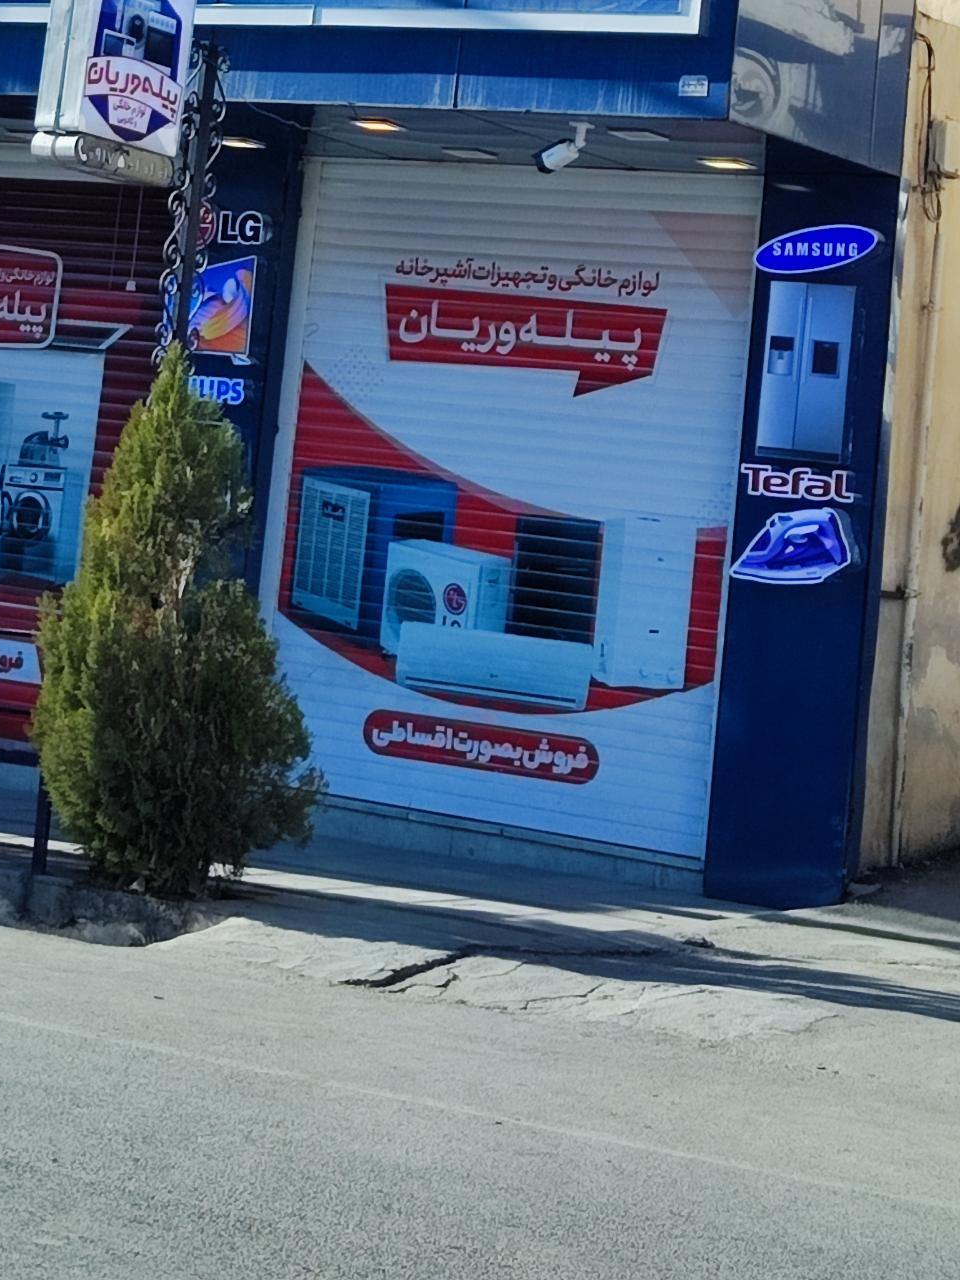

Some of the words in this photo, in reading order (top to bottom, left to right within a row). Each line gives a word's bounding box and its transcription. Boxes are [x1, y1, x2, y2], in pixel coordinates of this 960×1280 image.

[219, 210, 263, 245] LG
[772, 242, 859, 257] SAMSUNG
[472, 261, 549, 290] تجهیزات
[558, 264, 617, 291] خانگی
[618, 270, 660, 297] لوازم
[741, 463, 855, 503] Tefal
[372, 720, 453, 750] اقساطی
[453, 731, 523, 767] بصورت
[522, 737, 589, 775] فروش
